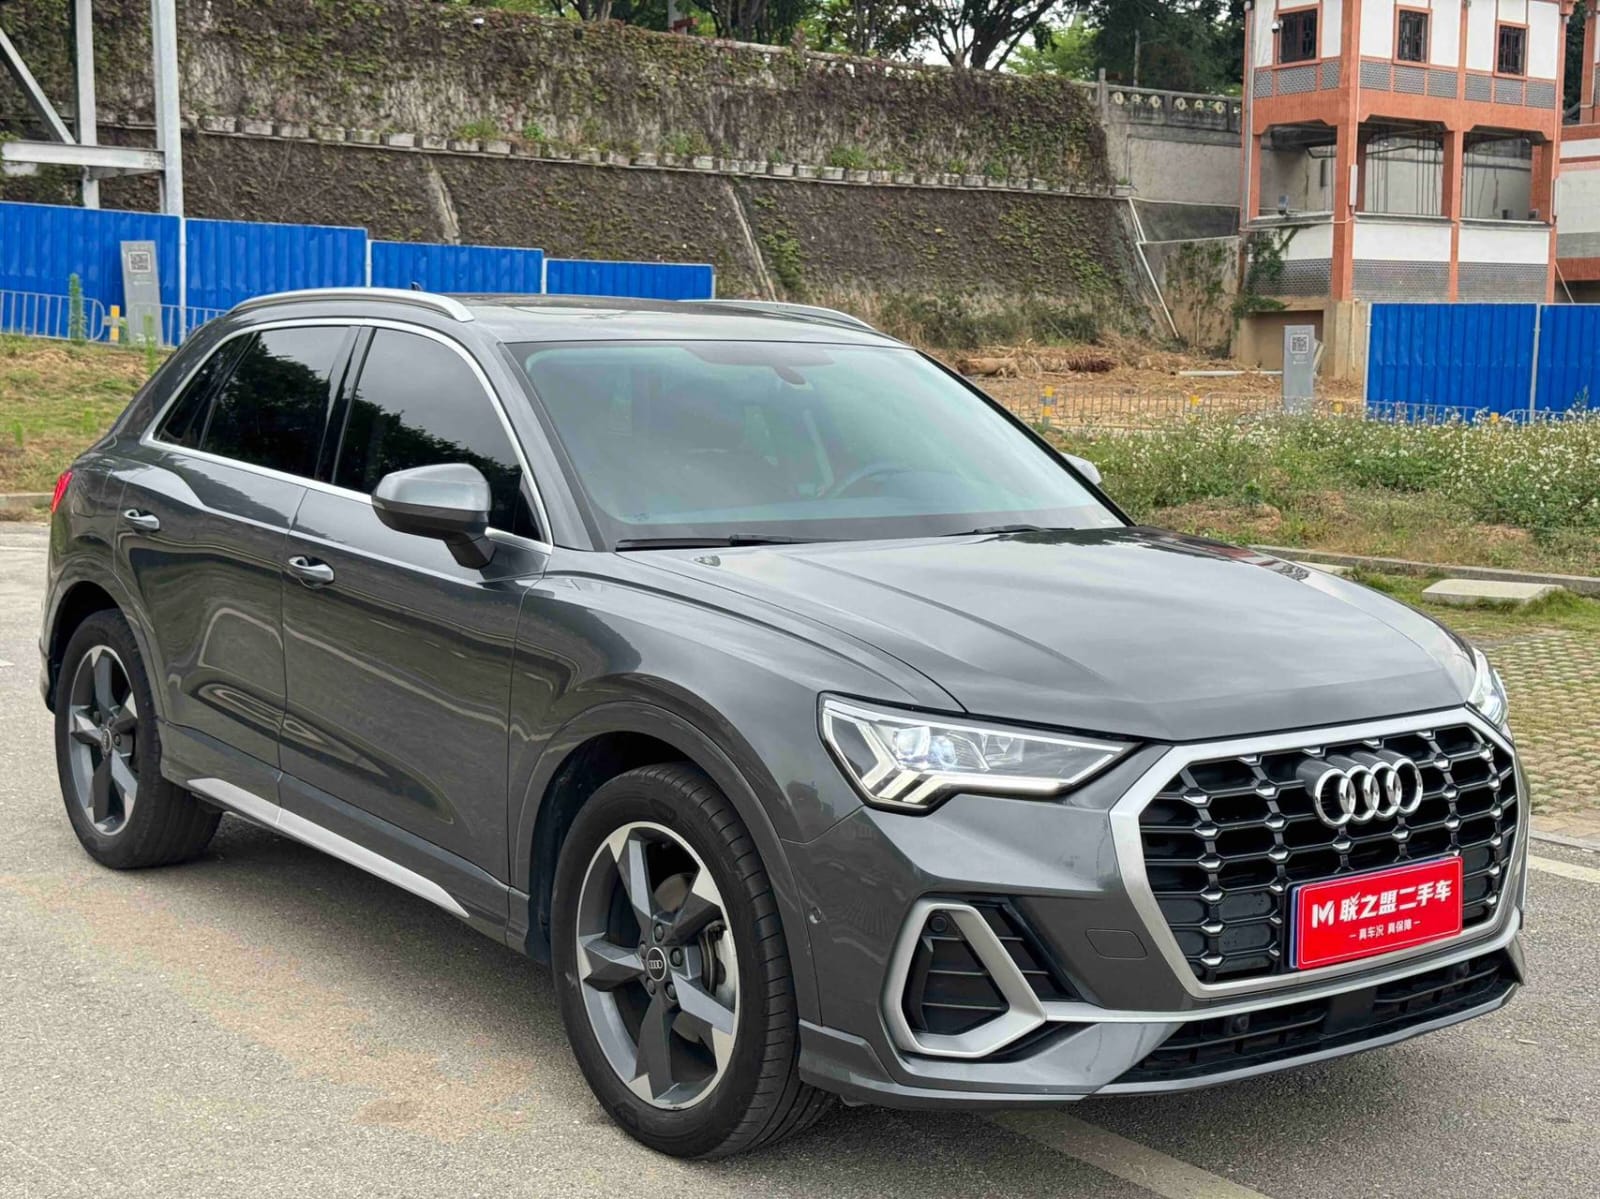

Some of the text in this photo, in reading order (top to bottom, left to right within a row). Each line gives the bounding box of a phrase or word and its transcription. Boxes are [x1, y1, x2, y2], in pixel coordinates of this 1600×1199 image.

[1339, 880, 1452, 922] 联之盟二手车
